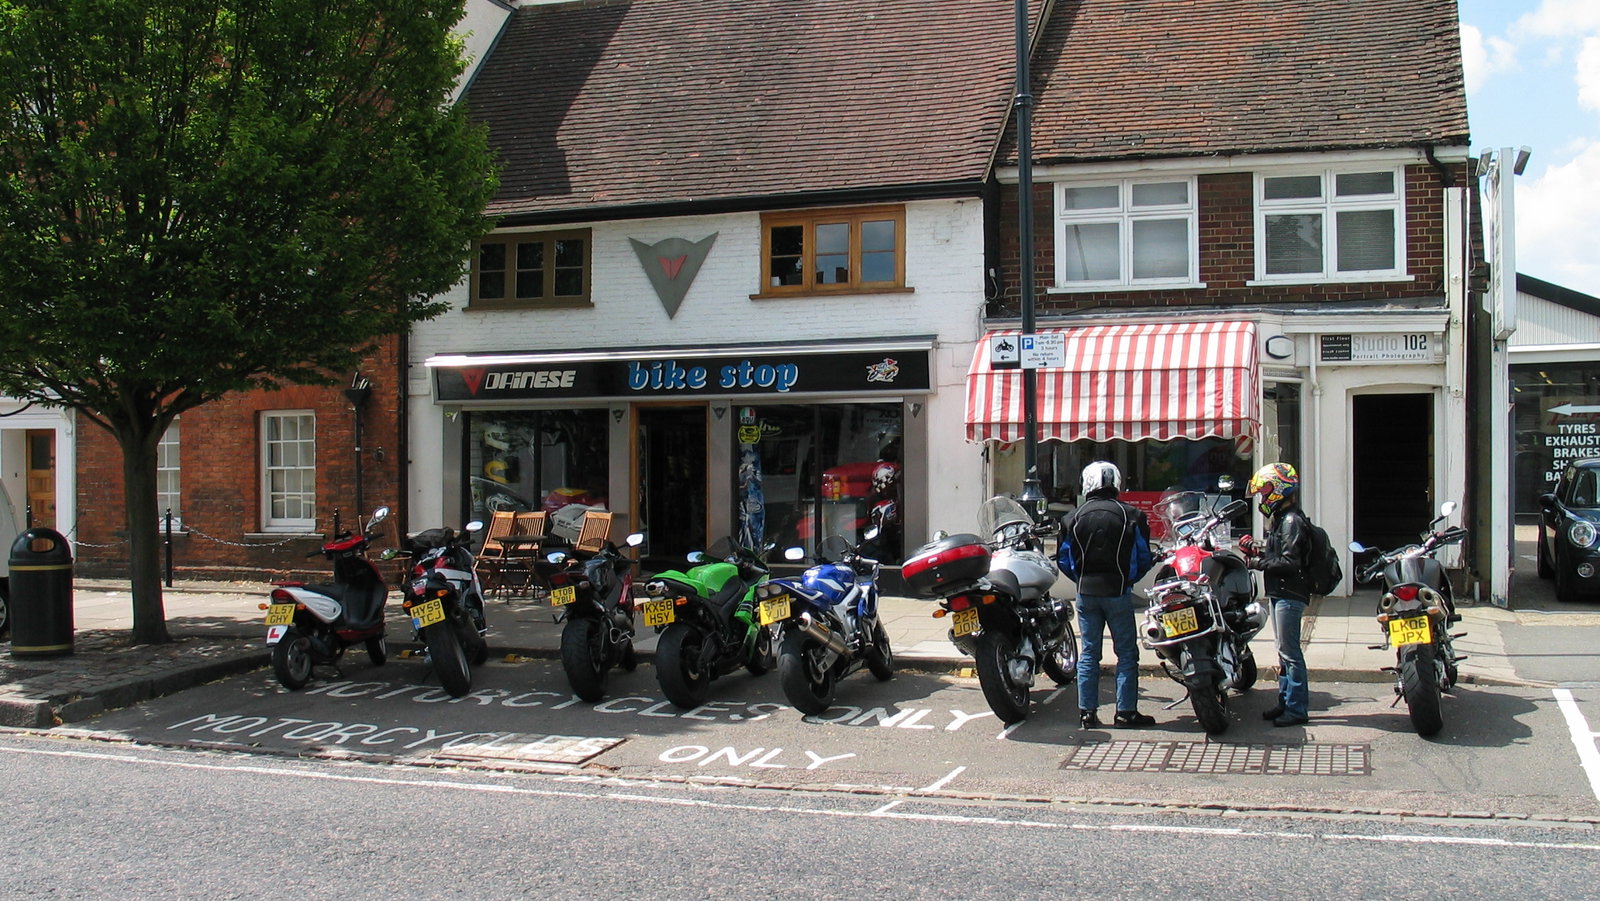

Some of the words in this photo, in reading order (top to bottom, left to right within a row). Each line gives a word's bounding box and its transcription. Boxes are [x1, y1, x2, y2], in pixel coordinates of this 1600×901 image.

[1024, 339, 1032, 349] P
[1353, 335, 1398, 351] Studio
[1402, 334, 1427, 350] 102
[628, 360, 707, 390] bike
[719, 360, 799, 392] stop
[1558, 423, 1596, 434] TYRES
[1553, 447, 1600, 458] BRAKES
[269, 605, 293, 615] LL57
[412, 600, 441, 617] HY59
[645, 600, 672, 614] KX58
[766, 607, 786, 620] YJU
[269, 614, 288, 624] GHY
[420, 610, 441, 624] TCJ
[650, 611, 669, 624] HSY
[954, 608, 976, 624] 222
[956, 619, 978, 635] JON
[1172, 618, 1196, 632] YCN
[1391, 618, 1427, 632] LK06
[269, 628, 279, 639] L
[1398, 629, 1424, 644] JPX
[802, 705, 995, 732] ONLY
[166, 713, 618, 757] MOTORCYCLES
[658, 744, 857, 770] ONLY
